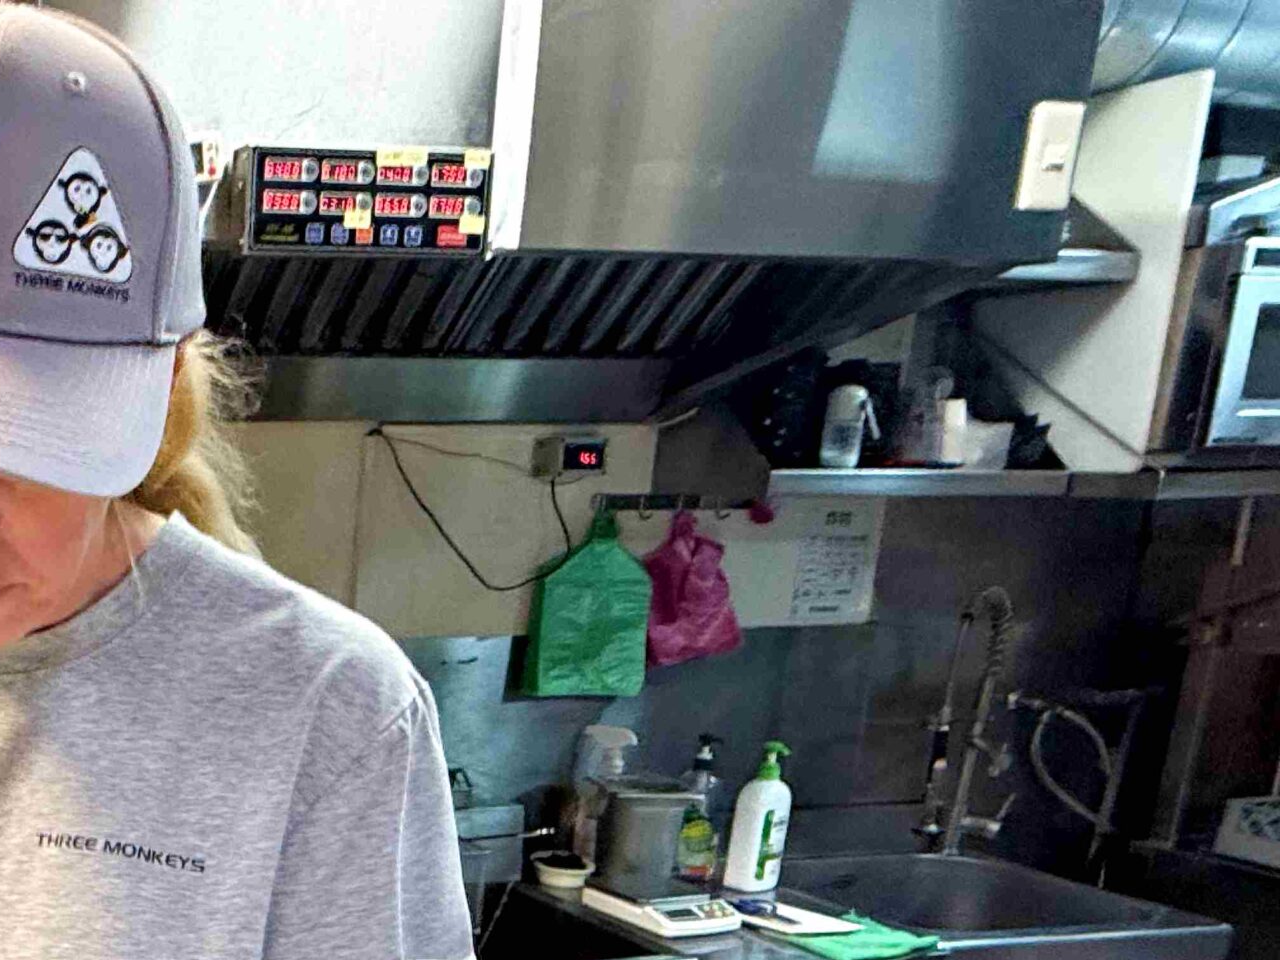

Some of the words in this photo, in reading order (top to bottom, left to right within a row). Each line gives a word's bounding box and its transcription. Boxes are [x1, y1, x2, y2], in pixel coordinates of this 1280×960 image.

[15, 271, 63, 290] THREE
[36, 832, 98, 851] THREE
[103, 840, 206, 873] MONKEYS
